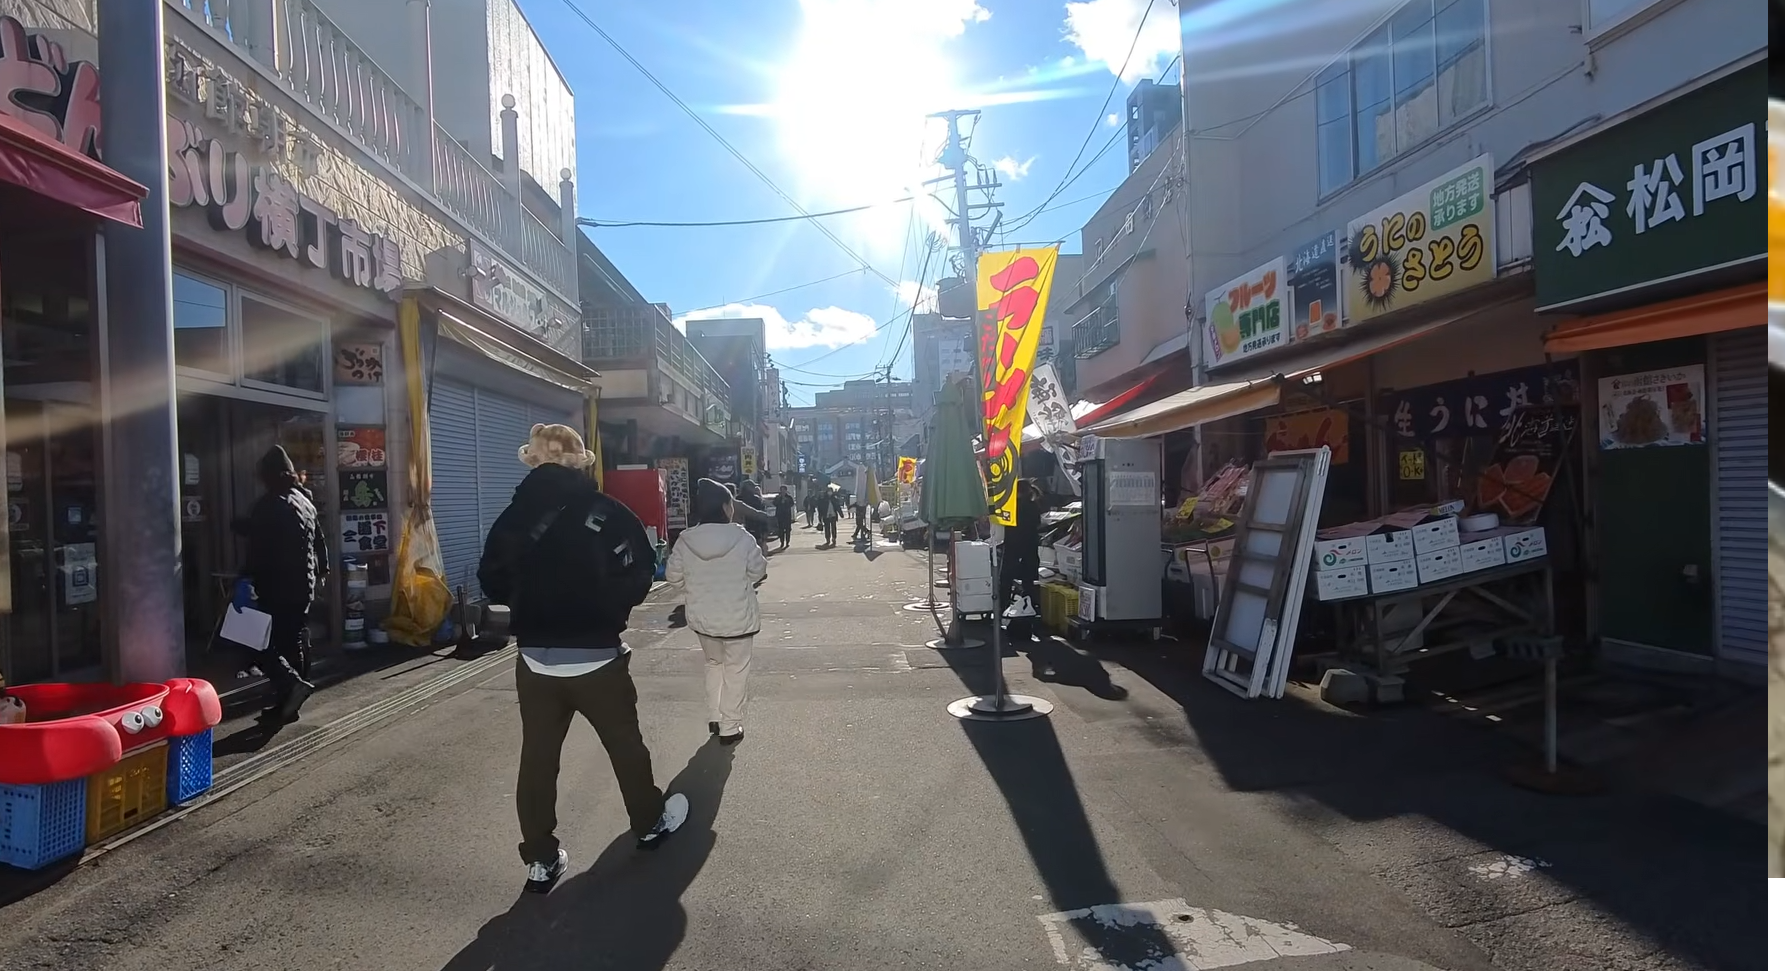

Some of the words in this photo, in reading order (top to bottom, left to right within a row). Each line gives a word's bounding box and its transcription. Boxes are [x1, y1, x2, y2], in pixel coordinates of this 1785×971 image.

[1433, 173, 1480, 207] 地方発送
[1627, 121, 1769, 235] 松岡
[1433, 193, 1480, 227] 承ります
[1359, 211, 1426, 263] うにの
[1402, 223, 1484, 291] さとう
[1228, 271, 1277, 313] フルーツ
[1239, 299, 1280, 340] 専門店
[1243, 332, 1281, 353] 地方発送承ります
[984, 256, 1039, 459] ラーメン
[1394, 382, 1532, 438] 生うに丼
